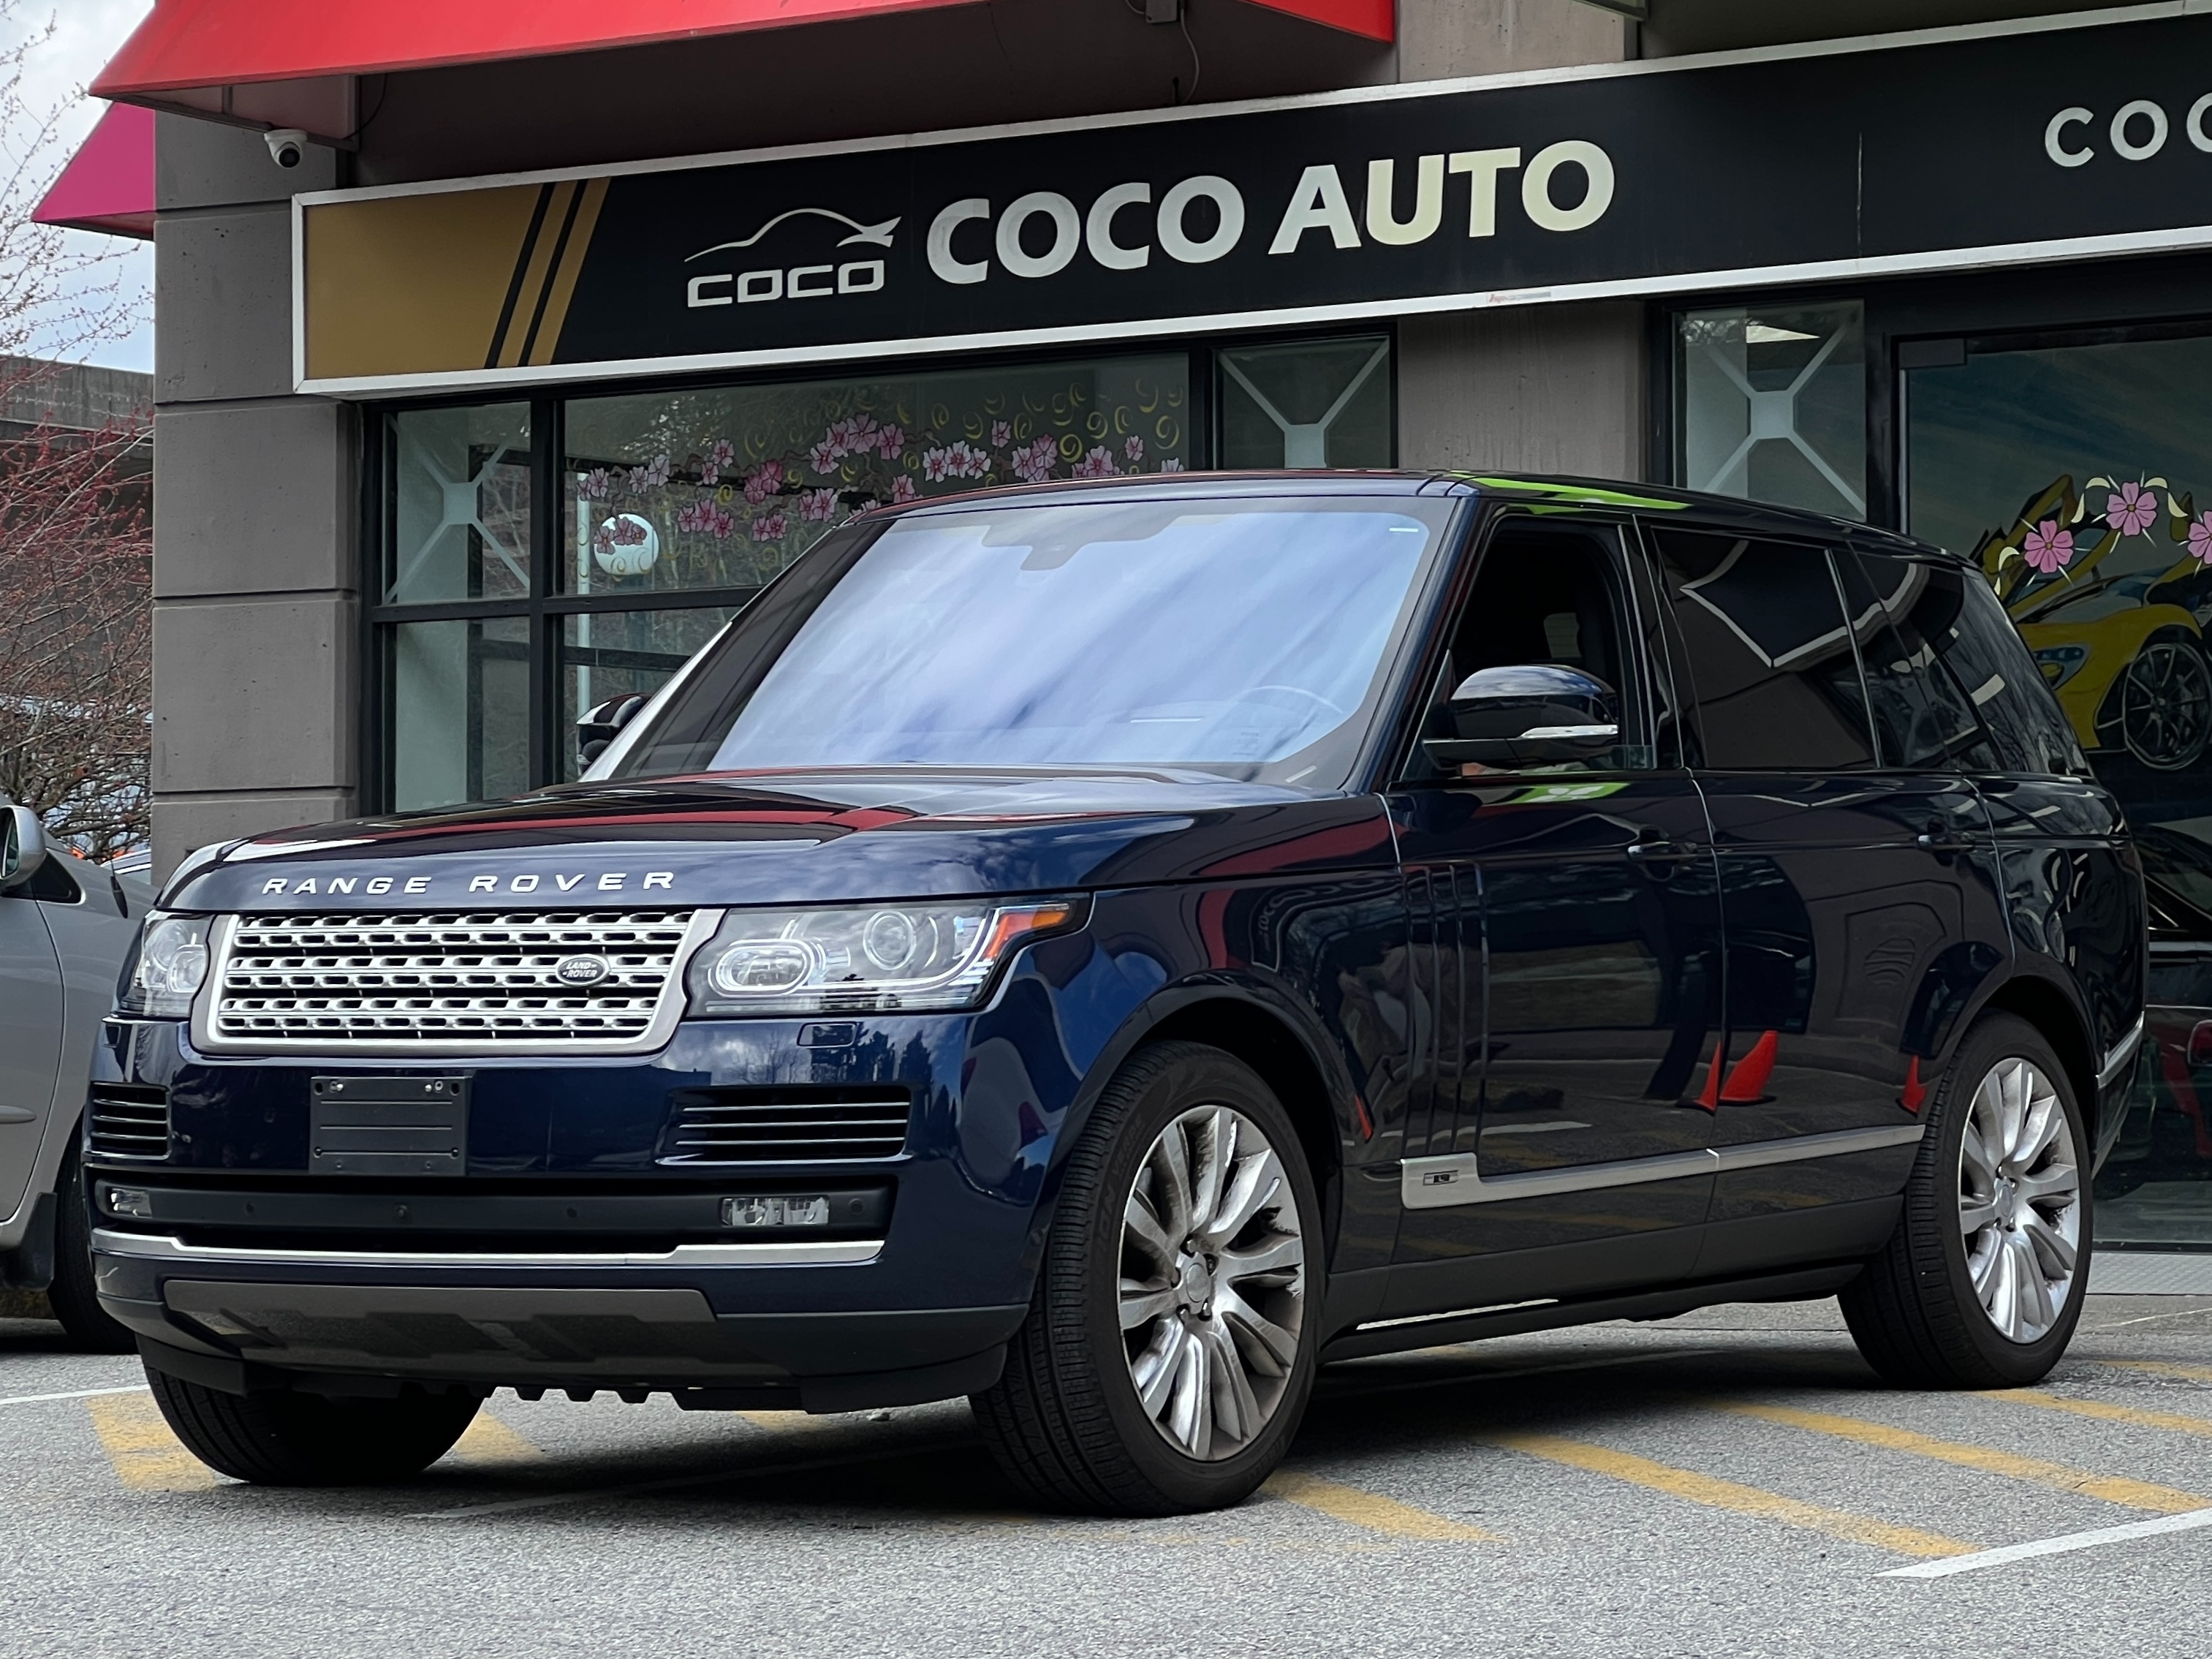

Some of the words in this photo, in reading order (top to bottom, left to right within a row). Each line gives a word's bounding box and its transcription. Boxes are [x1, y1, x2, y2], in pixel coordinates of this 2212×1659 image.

[926, 175, 1245, 284] COCO
[1268, 140, 1615, 254] AUTO
[687, 260, 885, 308] COCO
[262, 877, 432, 894] RANGE
[469, 872, 674, 892] ROVER
[566, 970, 597, 978] ROVER
